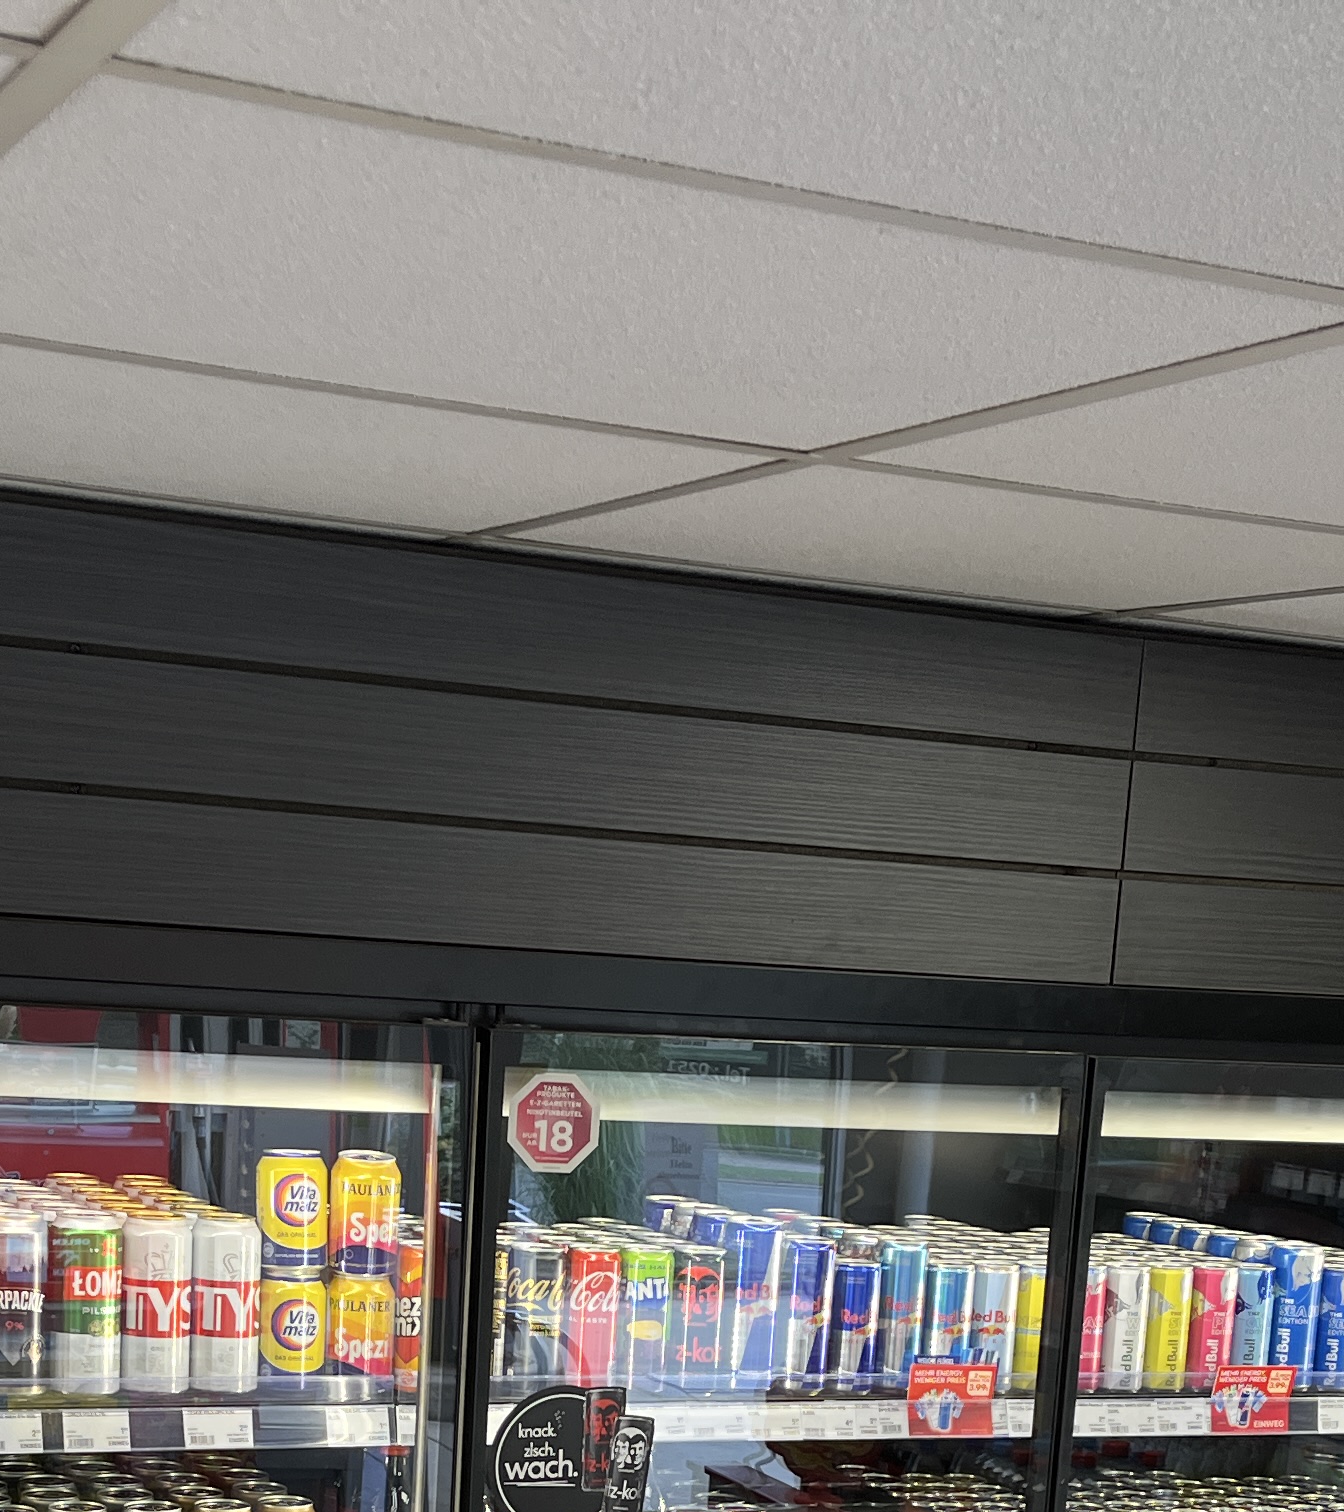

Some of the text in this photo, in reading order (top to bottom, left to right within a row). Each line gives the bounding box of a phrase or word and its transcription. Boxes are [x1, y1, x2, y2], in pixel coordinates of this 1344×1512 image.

[533, 1120, 574, 1153] 18
[290, 1187, 317, 1202] Vita
[284, 1199, 318, 1214] malz
[289, 1311, 315, 1326] Vita
[282, 1323, 317, 1338] malz
[518, 1422, 557, 1439] knack.
[523, 1442, 556, 1458] zisch.
[504, 1456, 578, 1480] wach.
